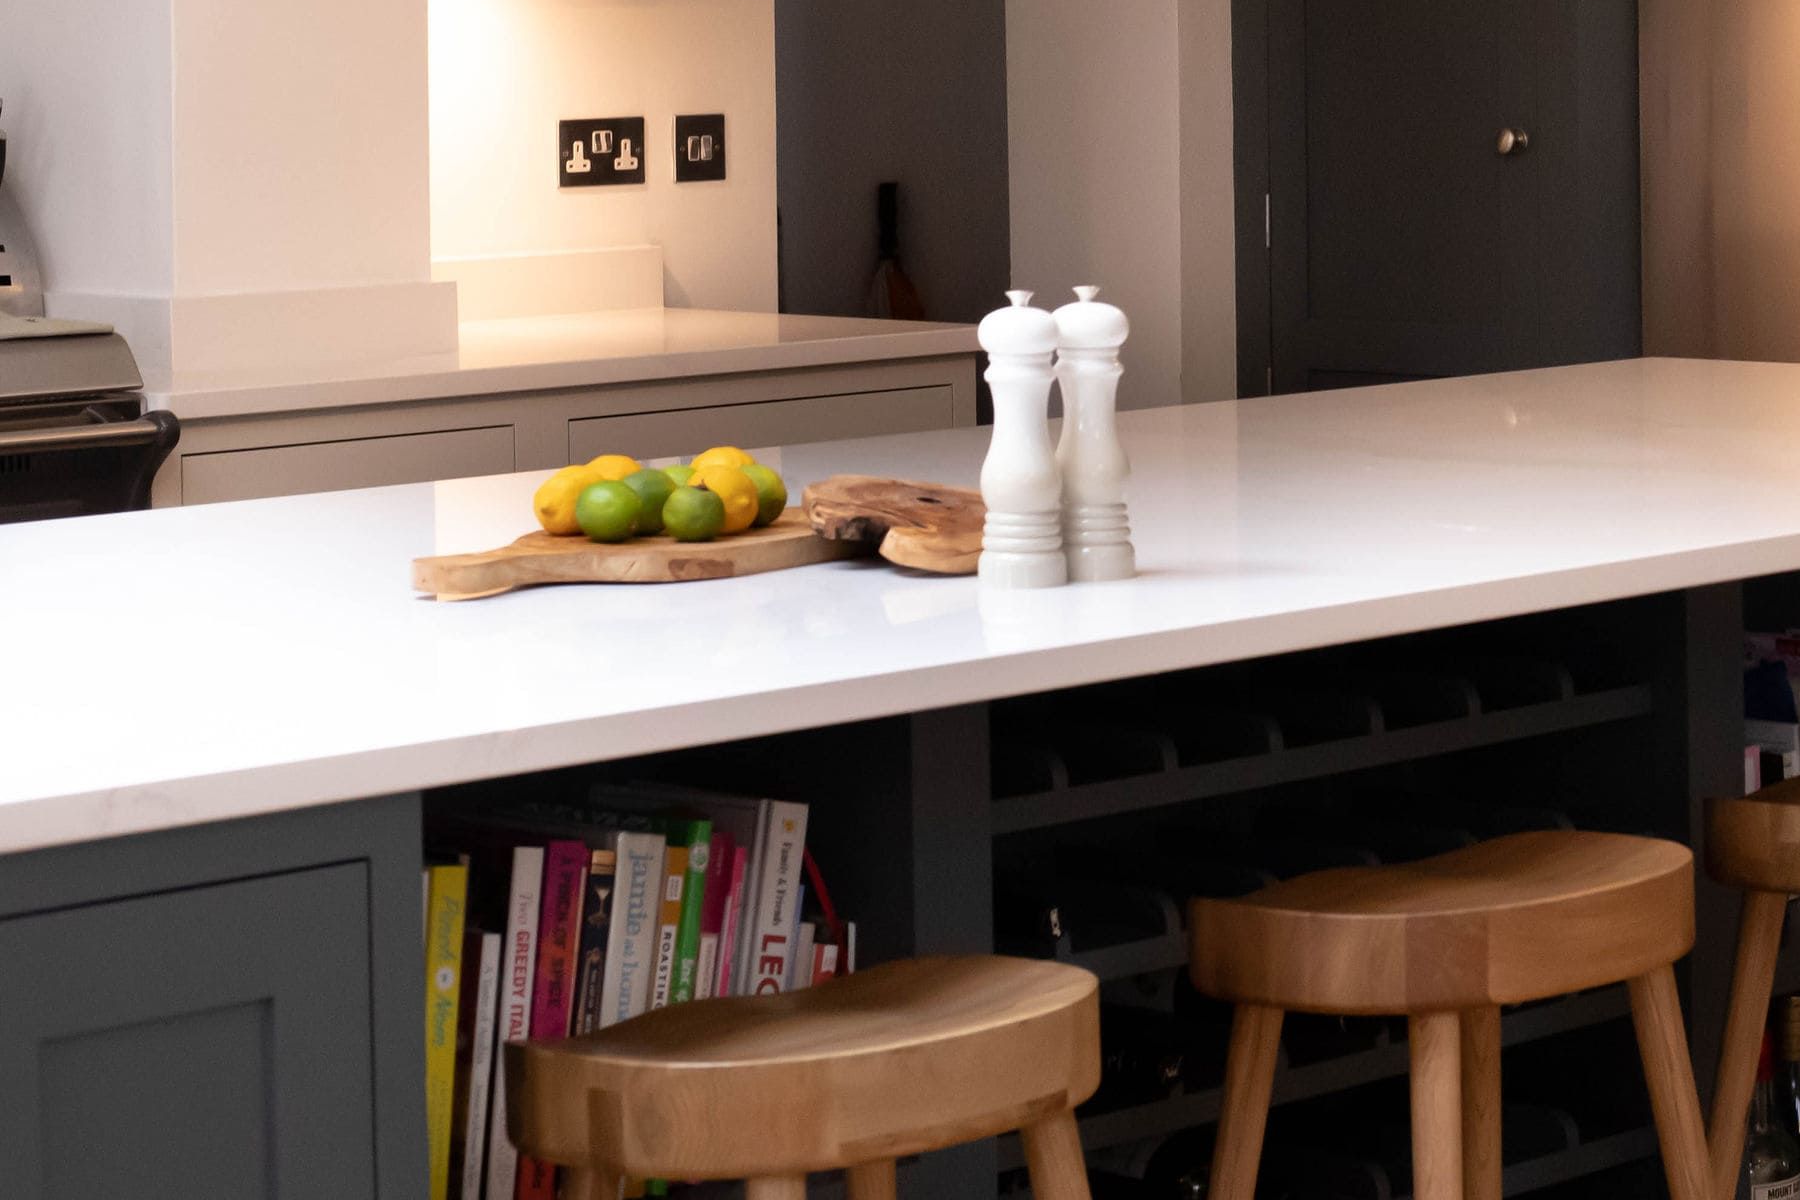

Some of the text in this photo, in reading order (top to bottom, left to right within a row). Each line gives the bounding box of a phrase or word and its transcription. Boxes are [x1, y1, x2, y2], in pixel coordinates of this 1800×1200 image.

[625, 851, 655, 935] jamie
[510, 929, 533, 999] GREEDY
[1767, 1184, 1793, 1200] MOUNT
